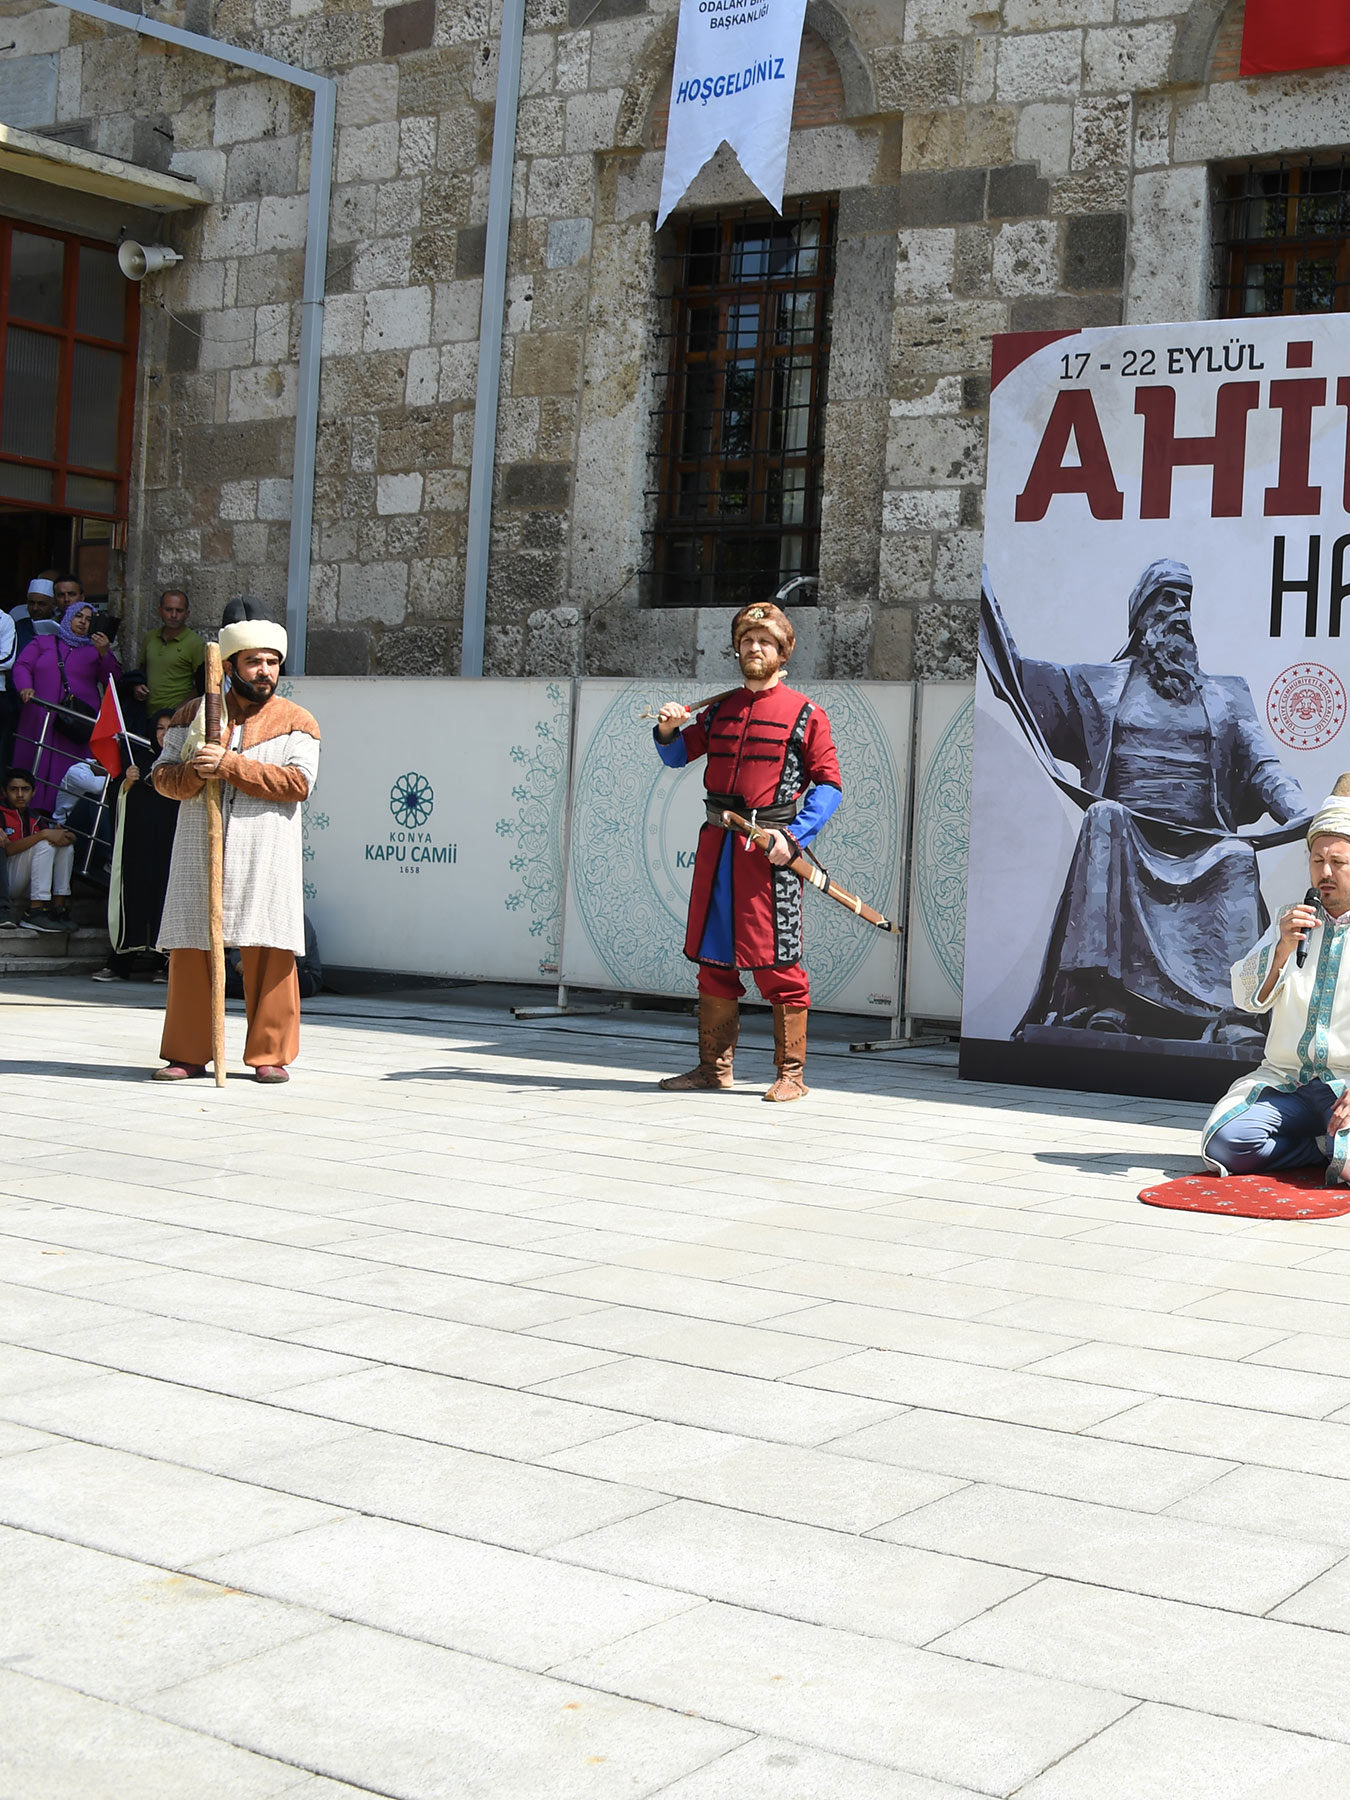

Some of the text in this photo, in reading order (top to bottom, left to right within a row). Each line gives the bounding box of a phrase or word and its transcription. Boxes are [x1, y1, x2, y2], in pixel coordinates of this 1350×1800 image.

[710, 4, 769, 30] BAŞKANLIĞI
[676, 54, 785, 106] HOŞGELDİNİZ
[1060, 353, 1091, 379] 17
[1121, 350, 1156, 376] 22
[1167, 338, 1264, 374] EYLÜL
[390, 832, 432, 843] KONYA
[365, 844, 406, 862] KAPU
[676, 851, 696, 868] KA
[400, 866, 420, 874] 1658
